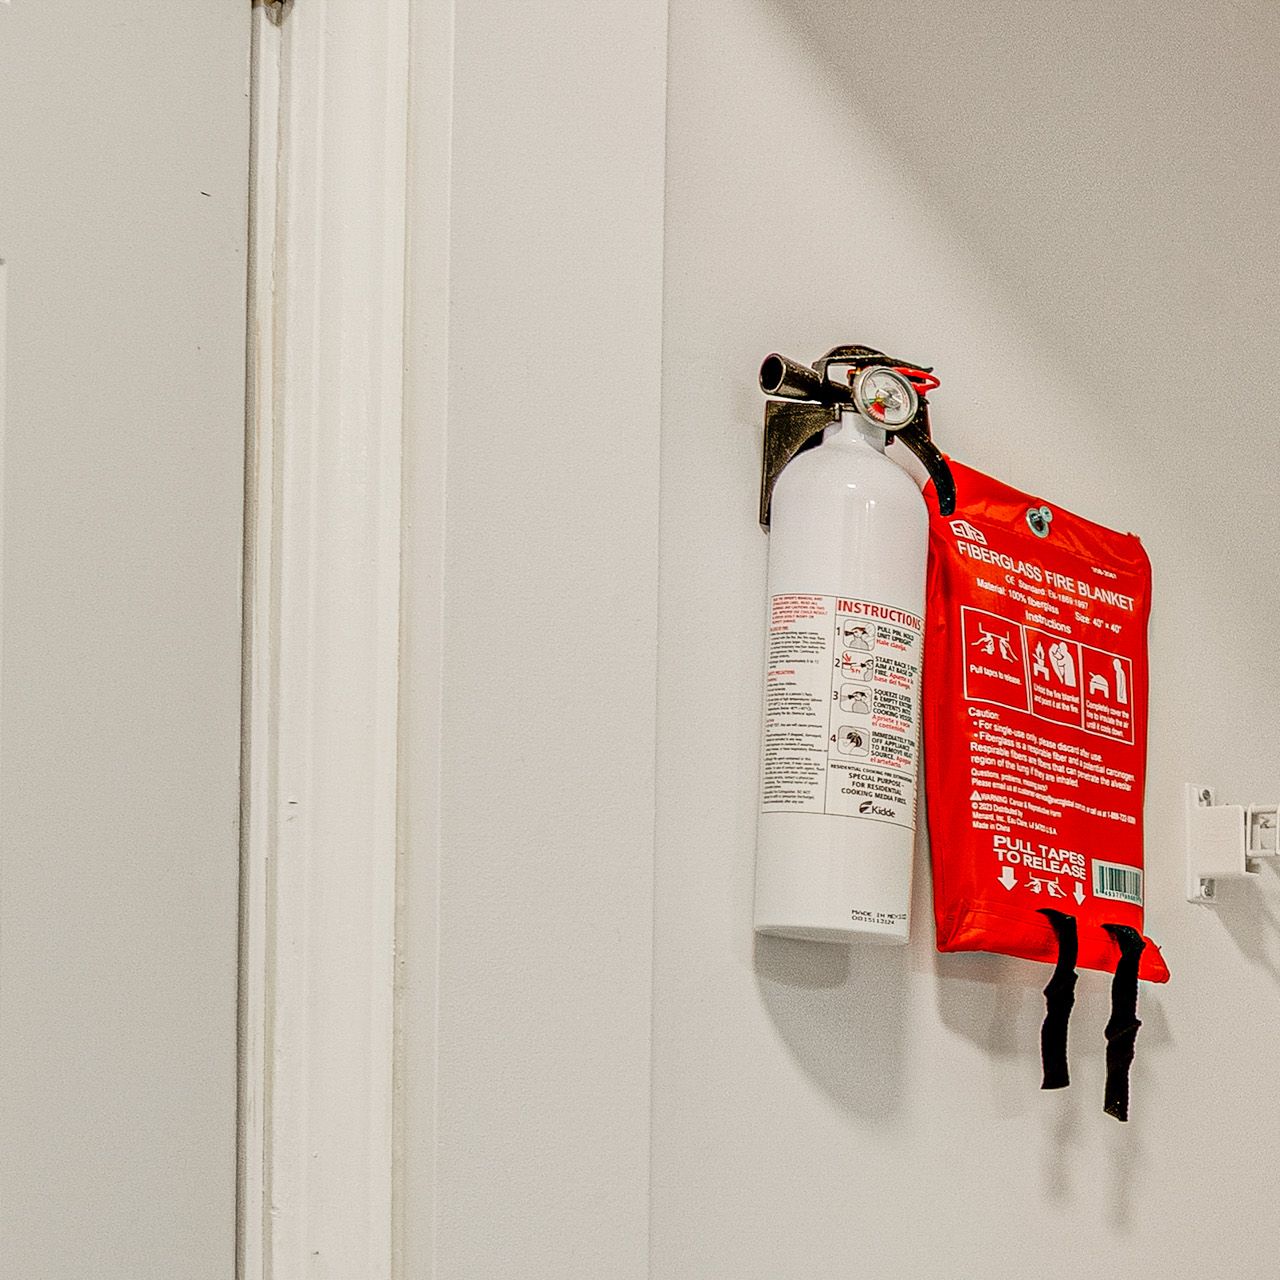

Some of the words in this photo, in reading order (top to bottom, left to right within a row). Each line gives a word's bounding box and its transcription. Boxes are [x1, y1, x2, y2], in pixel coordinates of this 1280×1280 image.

[957, 541, 1043, 582] FIBERGLASS
[1045, 572, 1075, 593] FIRE
[1078, 581, 1134, 611] BLANKET
[977, 578, 1006, 595] Material:
[1009, 590, 1026, 603] 100%
[1028, 597, 1059, 614] fiberglass
[838, 600, 920, 630] INSTRUCTIONS
[1025, 611, 1071, 634] Instructions
[837, 627, 840, 635] 1
[835, 658, 840, 667] 2
[833, 691, 838, 700] 3
[849, 773, 875, 782] SPECIAL
[867, 784, 901, 795] RESIDENTIAL
[872, 806, 895, 817] Kidde
[993, 835, 1035, 855] PULL
[1038, 845, 1085, 866] TAPES
[993, 849, 1020, 863] TO
[1023, 855, 1086, 880] RELEASE
